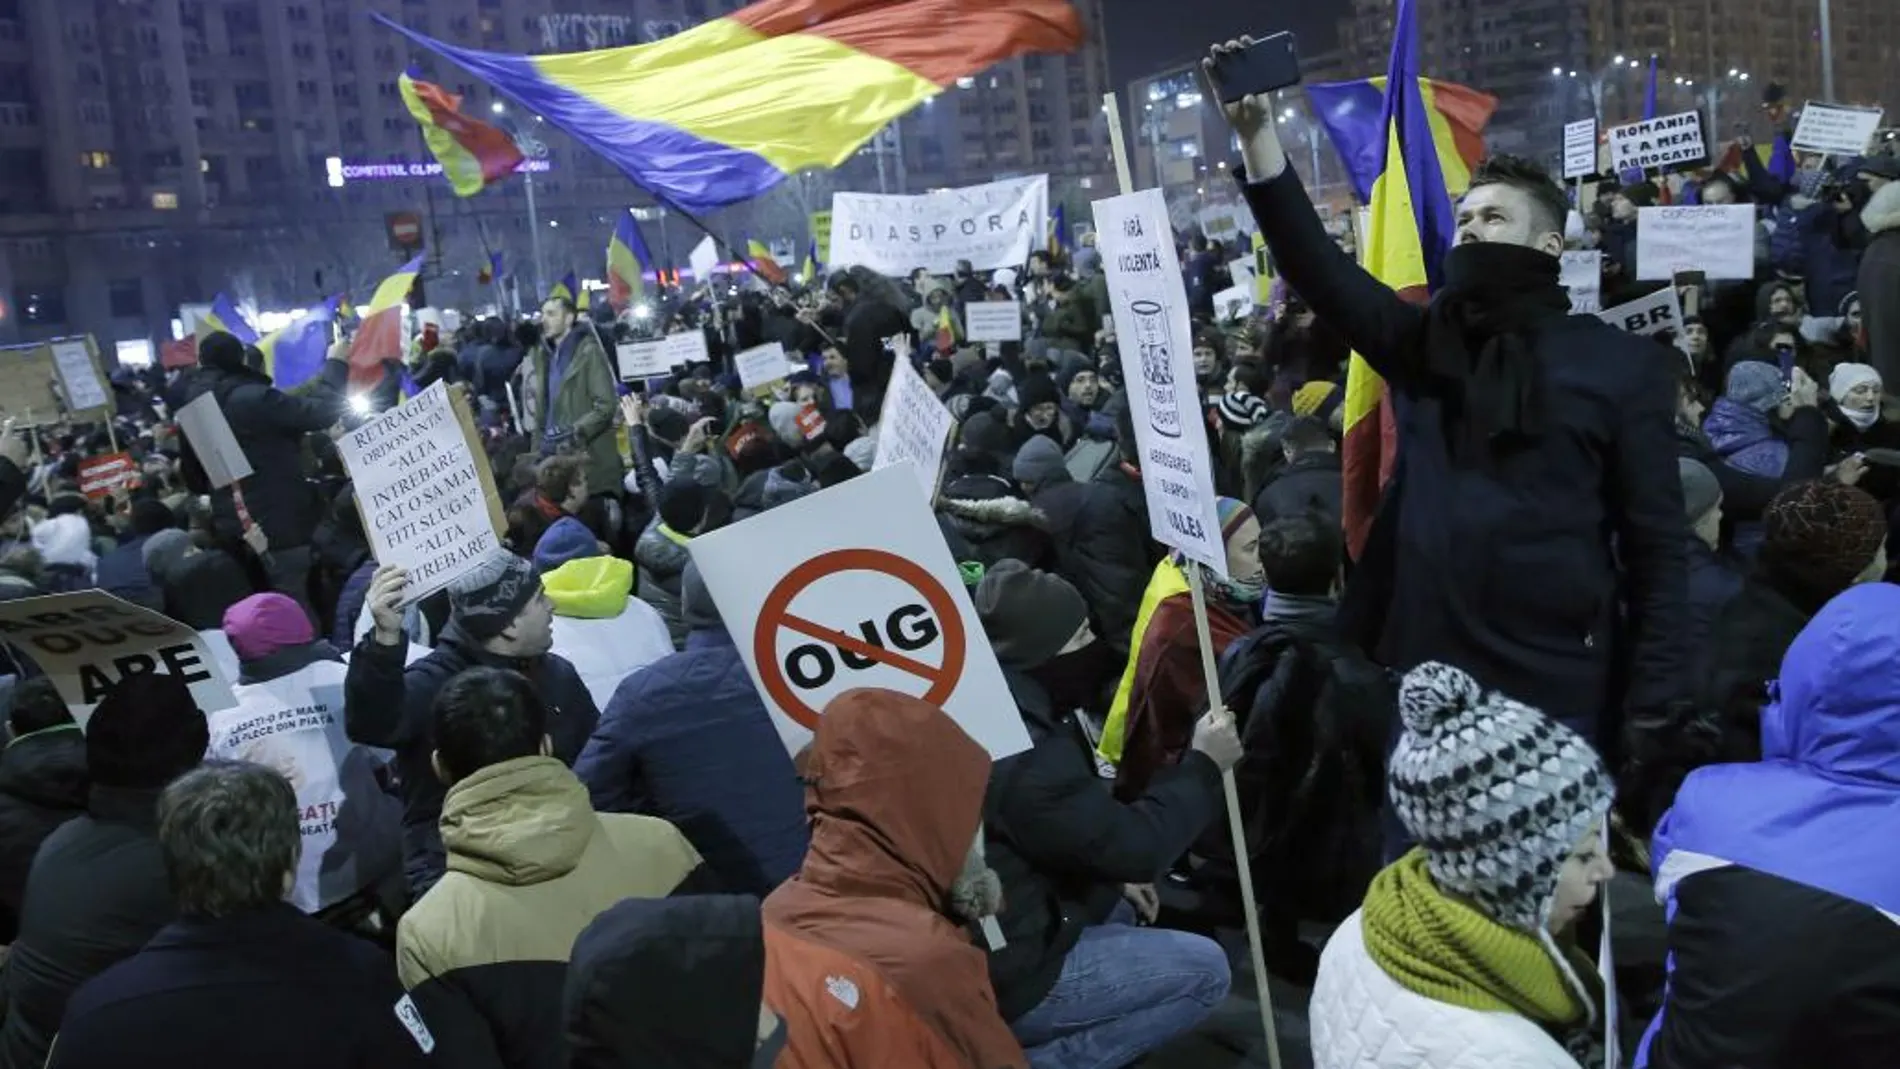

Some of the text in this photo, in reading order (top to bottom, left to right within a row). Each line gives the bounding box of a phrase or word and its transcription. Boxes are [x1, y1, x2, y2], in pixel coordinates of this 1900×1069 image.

[1615, 114, 1697, 140] ROMANIA
[1621, 143, 1631, 155] E
[1639, 141, 1652, 152] A
[850, 209, 1030, 243] DIASPORA
[1625, 304, 1673, 331] BR
[400, 531, 492, 588] NTREBARE"
[31, 619, 176, 654] OUG
[784, 604, 939, 690] OUG
